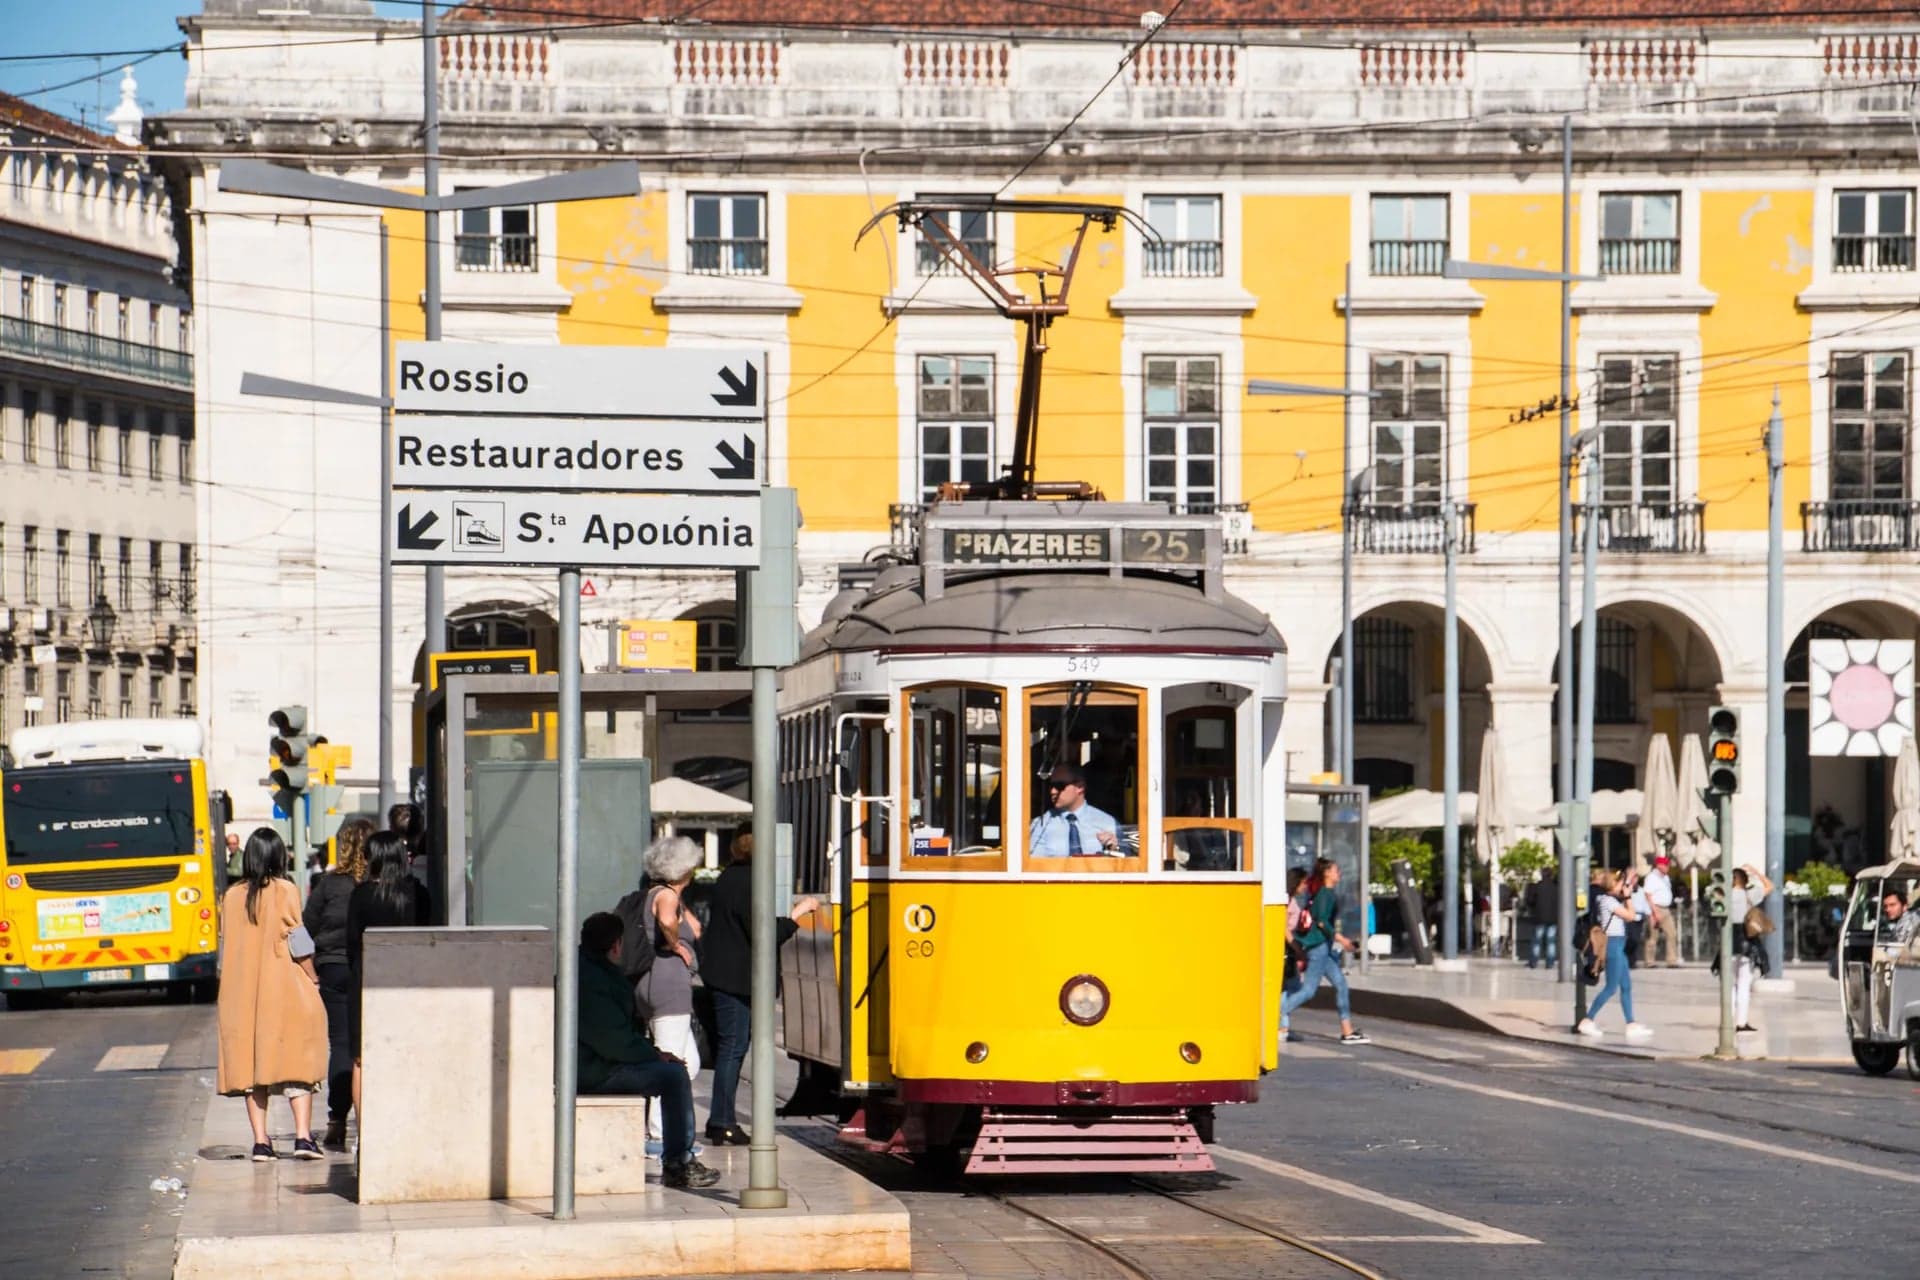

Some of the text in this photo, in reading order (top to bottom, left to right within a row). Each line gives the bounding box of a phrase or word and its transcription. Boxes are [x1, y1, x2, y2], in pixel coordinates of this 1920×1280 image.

[400, 360, 529, 394] Rossio
[398, 435, 684, 472] Restauradores
[954, 530, 1189, 562] PRAZERES 25
[1067, 657, 1100, 673] 549
